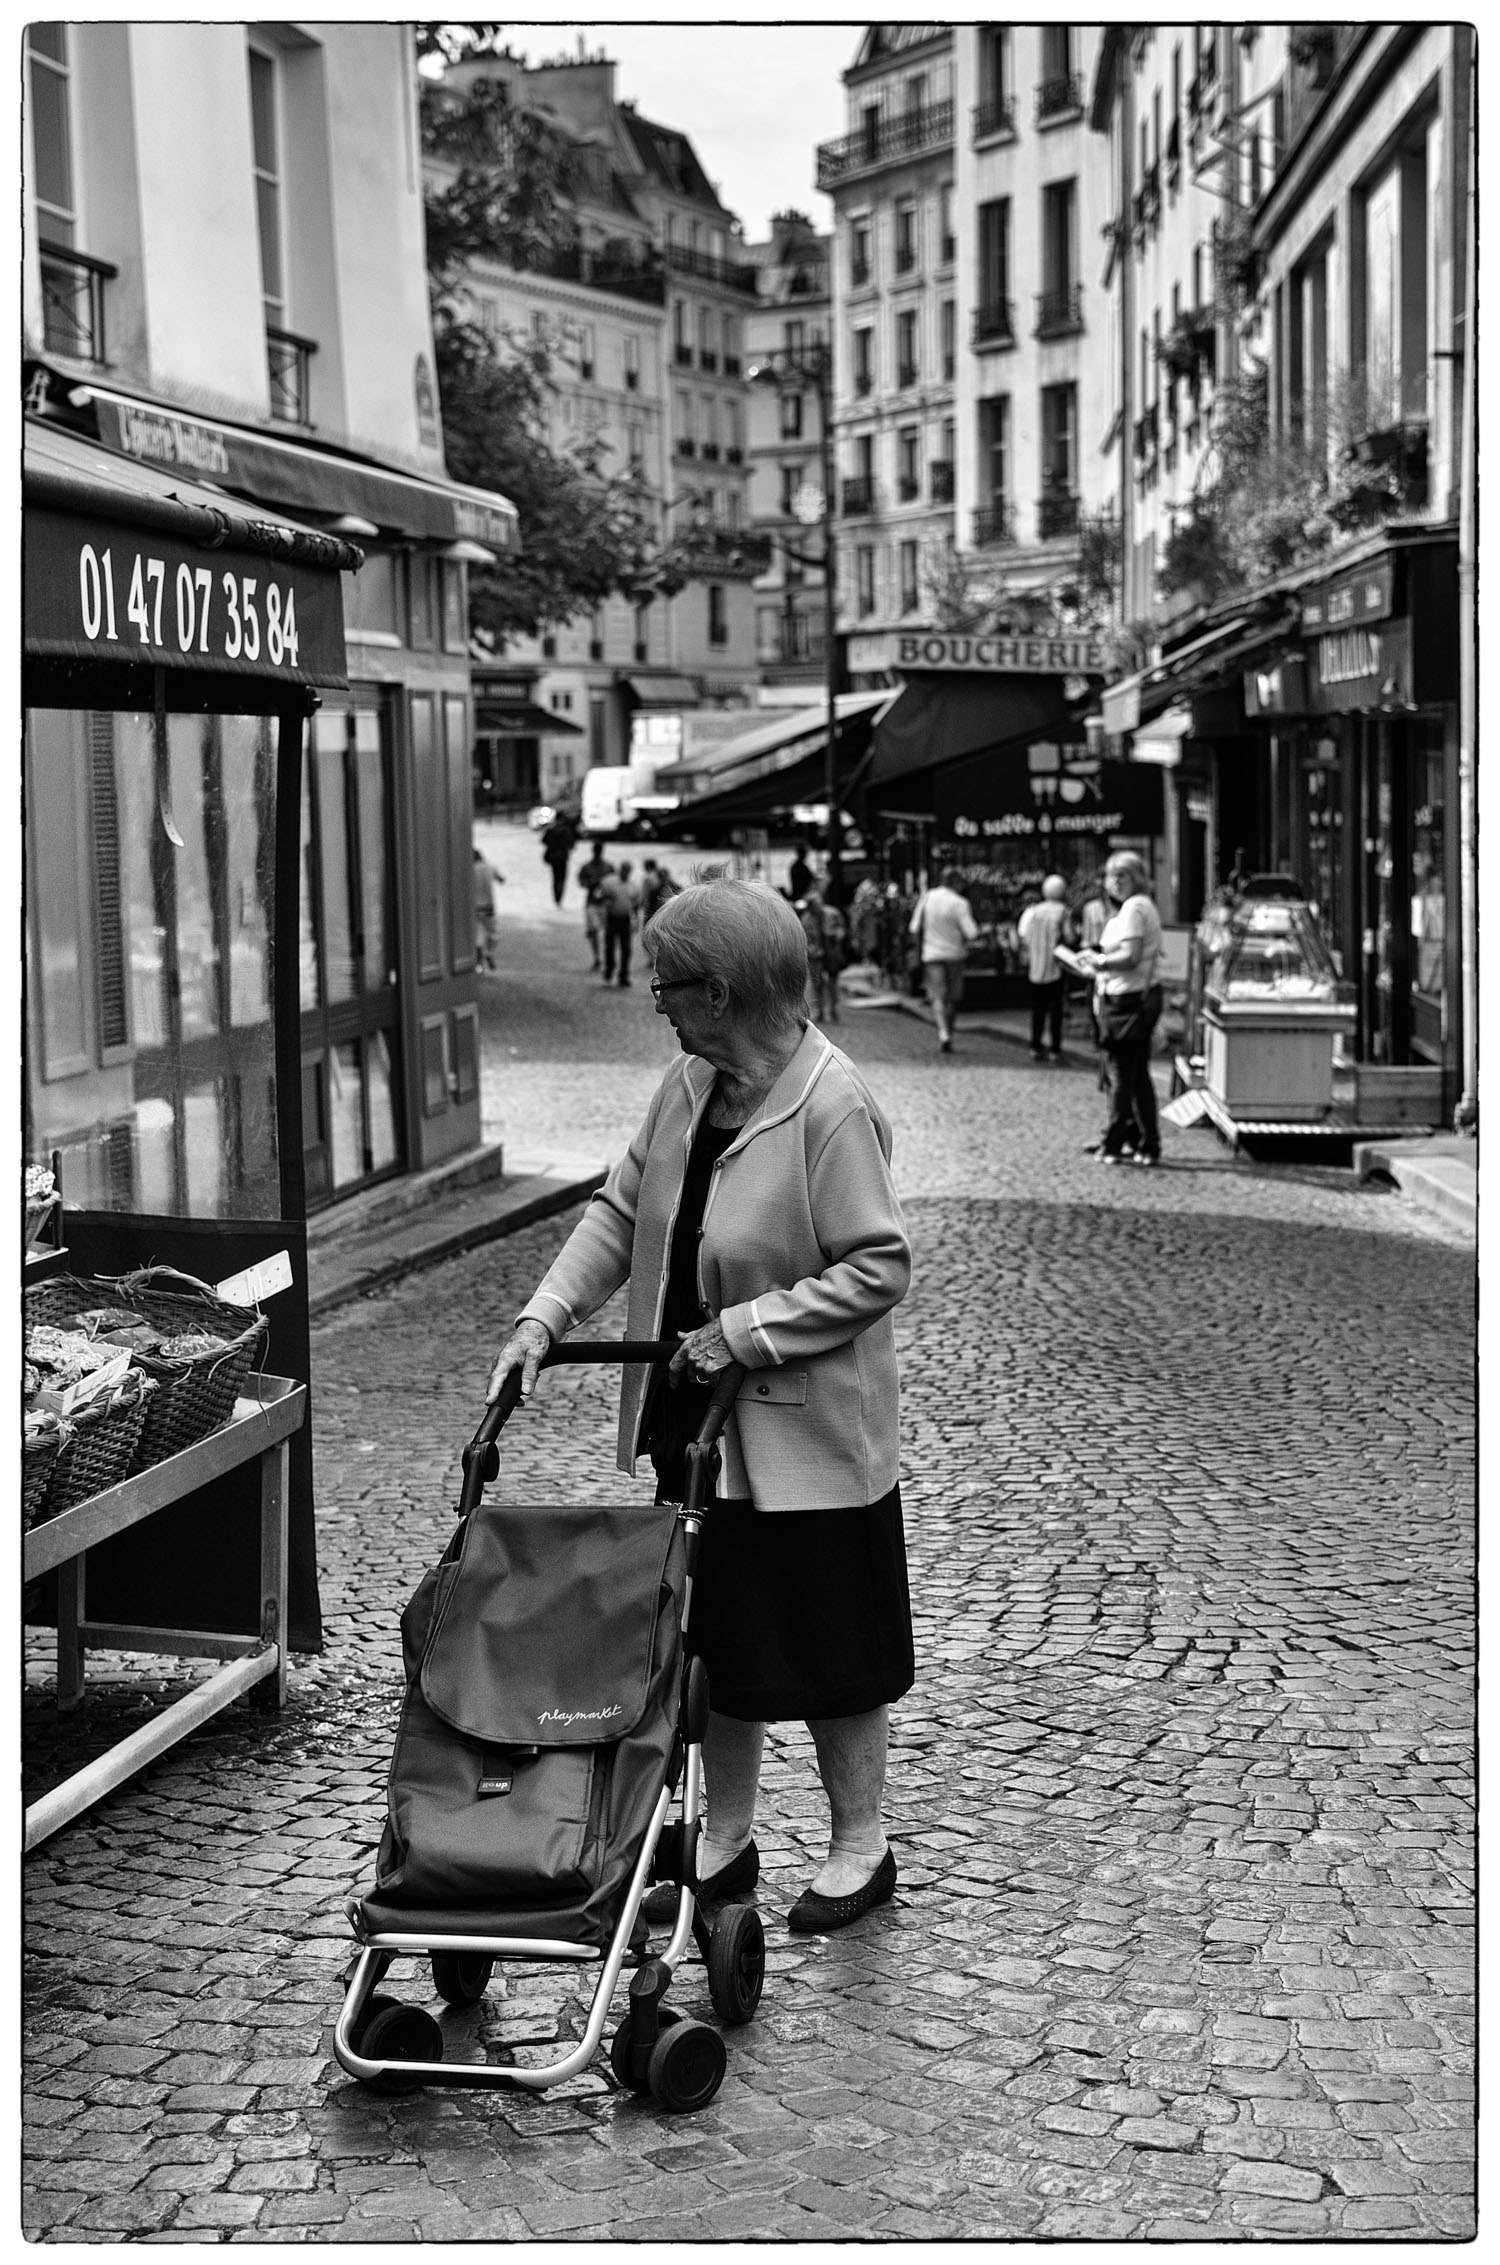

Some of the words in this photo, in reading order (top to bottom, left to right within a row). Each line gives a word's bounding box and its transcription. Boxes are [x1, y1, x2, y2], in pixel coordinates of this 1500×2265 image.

[80, 544, 118, 639] 01
[128, 554, 165, 646] 47
[177, 563, 212, 652] 07
[223, 572, 260, 661] 35
[267, 583, 298, 667] 84
[901, 638, 1102, 667] BOUCHERIE
[982, 813, 1035, 835] salle
[1054, 812, 1123, 835] manger
[537, 1703, 622, 1727] playmarket
